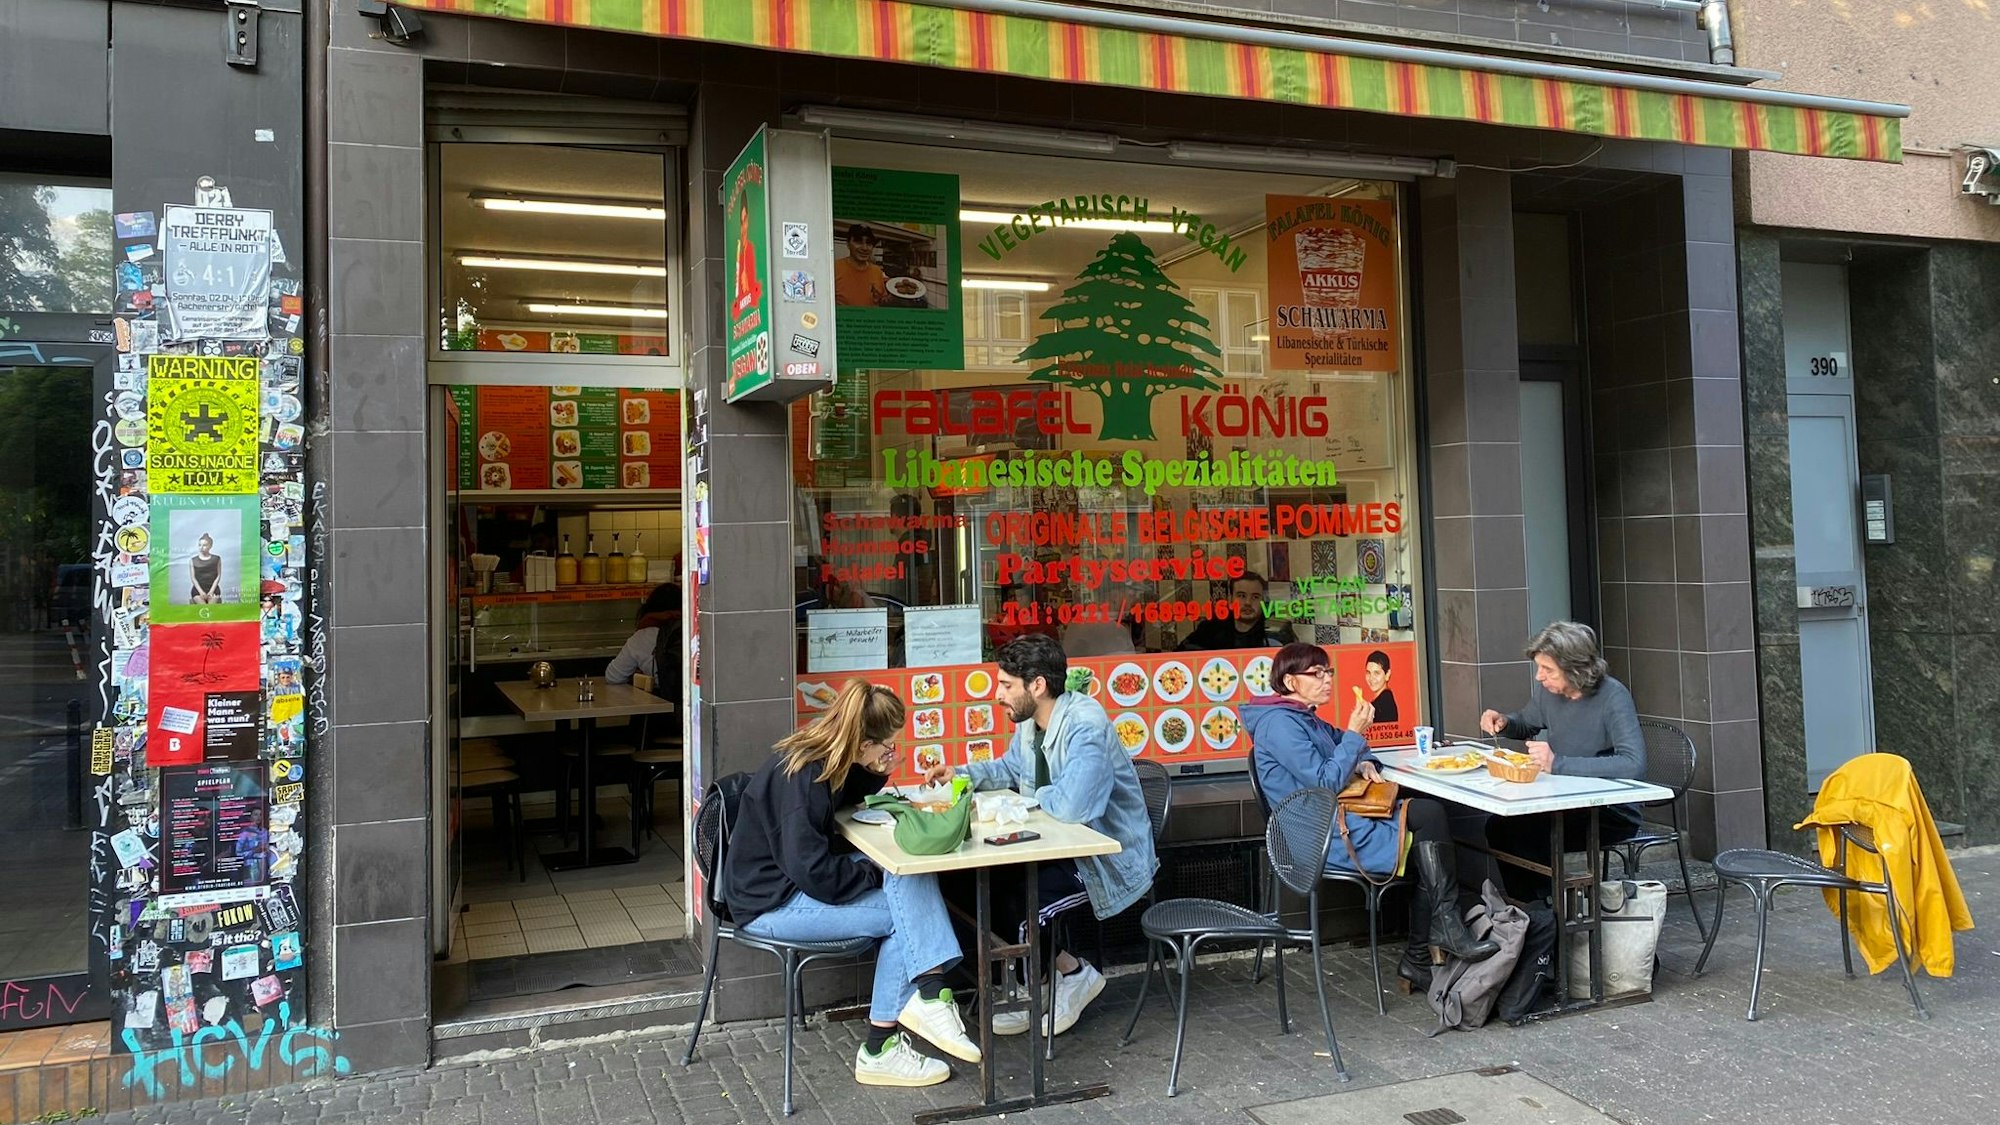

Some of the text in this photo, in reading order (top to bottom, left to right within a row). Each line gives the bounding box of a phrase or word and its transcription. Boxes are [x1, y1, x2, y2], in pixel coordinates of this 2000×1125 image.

[195, 212, 244, 227] DERBY
[1267, 203, 1391, 247] FALAFEL KÖNIG
[171, 225, 267, 242] TREFFPUNKT
[978, 194, 1148, 262] VEGETARISCH
[1171, 206, 1248, 274] VEGAN
[189, 242, 218, 252] ALLE
[220, 243, 232, 253] IN
[1303, 273, 1359, 288] AKKUS
[1276, 305, 1389, 331] SCHAWARMA
[1276, 335, 1389, 351] Libanesische & Türkische
[152, 358, 255, 379] WARNING
[1304, 351, 1363, 368] Spezialitäten
[1810, 356, 1838, 377] 390
[1179, 383, 1330, 439] KÖNIG
[205, 455, 254, 469] NAONE
[882, 448, 1114, 490] Libanesische
[1120, 448, 1338, 496] Spezialitäten
[184, 471, 223, 486] T.O.W.
[822, 511, 969, 532] Schawarma
[984, 501, 1402, 546] ORIGINALE BELGISCHE POMMES
[820, 560, 905, 584] Falafel
[995, 549, 1246, 588] Partyservice
[1296, 575, 1367, 595] VEGAN
[1057, 602, 1111, 626] 0221
[1130, 600, 1242, 625] 16899161
[1259, 596, 1402, 619] VEGETARISCH
[207, 698, 242, 708] Kleiner
[207, 706, 235, 717] Mann
[227, 713, 250, 724] nun?
[216, 903, 254, 928] FUKOW
